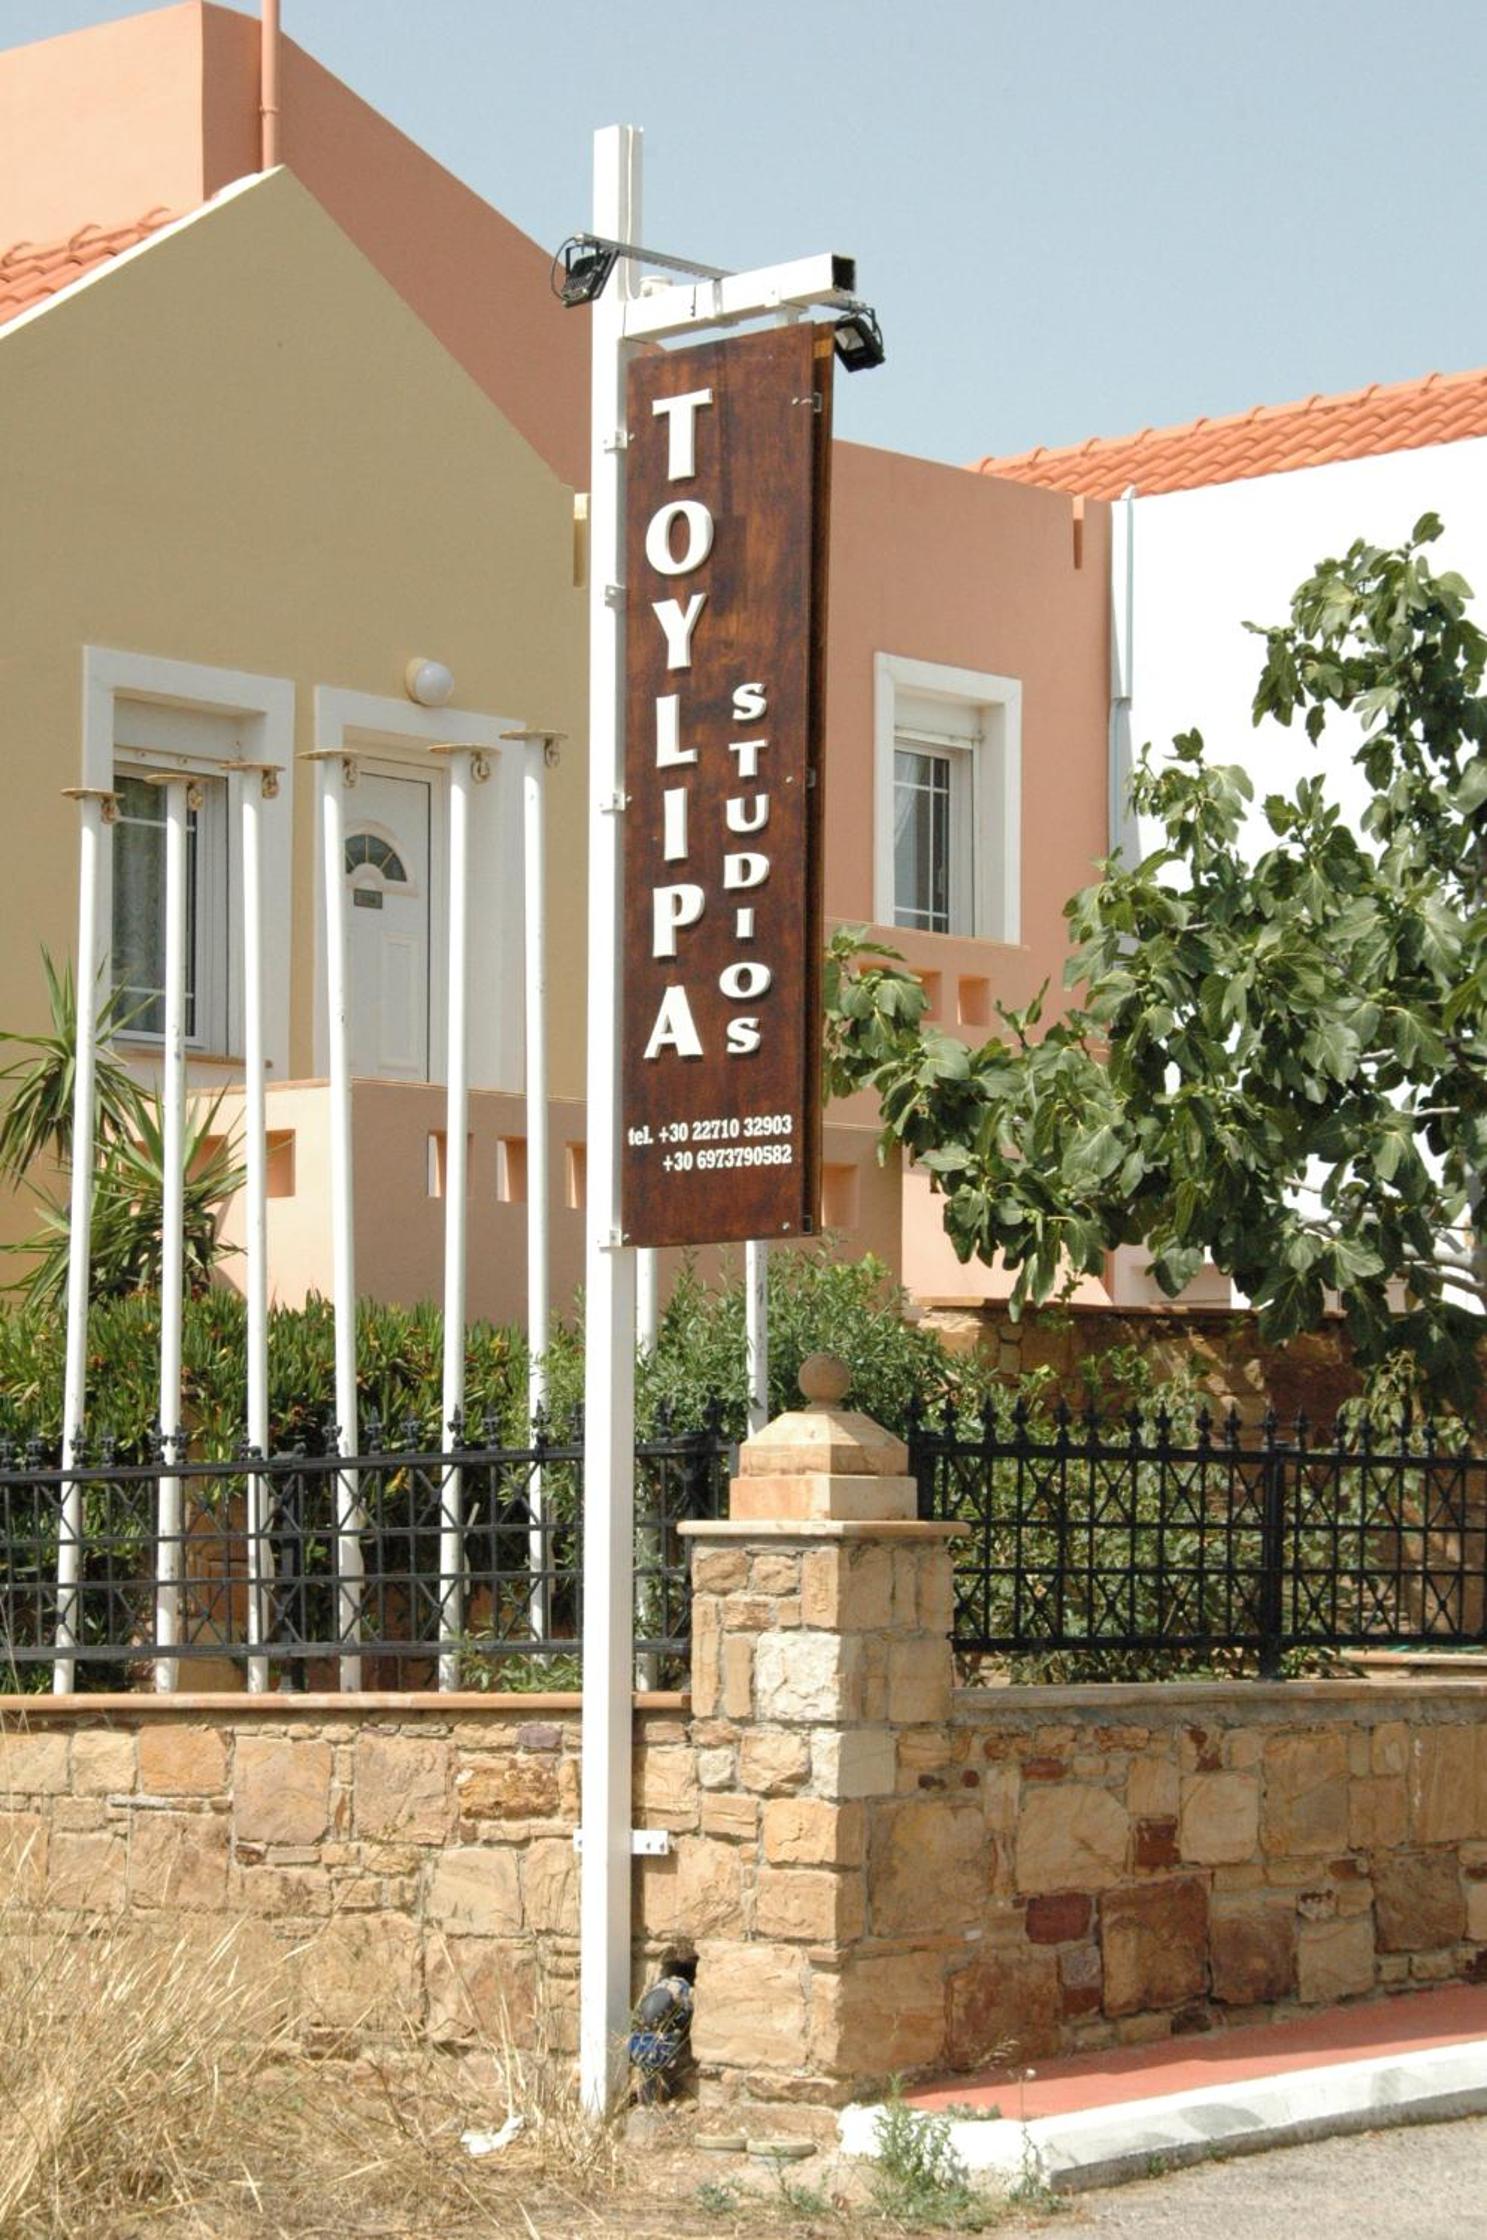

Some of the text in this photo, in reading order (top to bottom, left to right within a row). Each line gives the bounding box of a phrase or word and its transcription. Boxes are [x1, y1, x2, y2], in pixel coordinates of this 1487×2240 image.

[644, 387, 713, 1060] TOYLIPA
[719, 682, 771, 1055] STUDIOS
[627, 1114, 793, 1146] tel. +30 22710 32903
[662, 1144, 793, 1172] +30 6973790582
